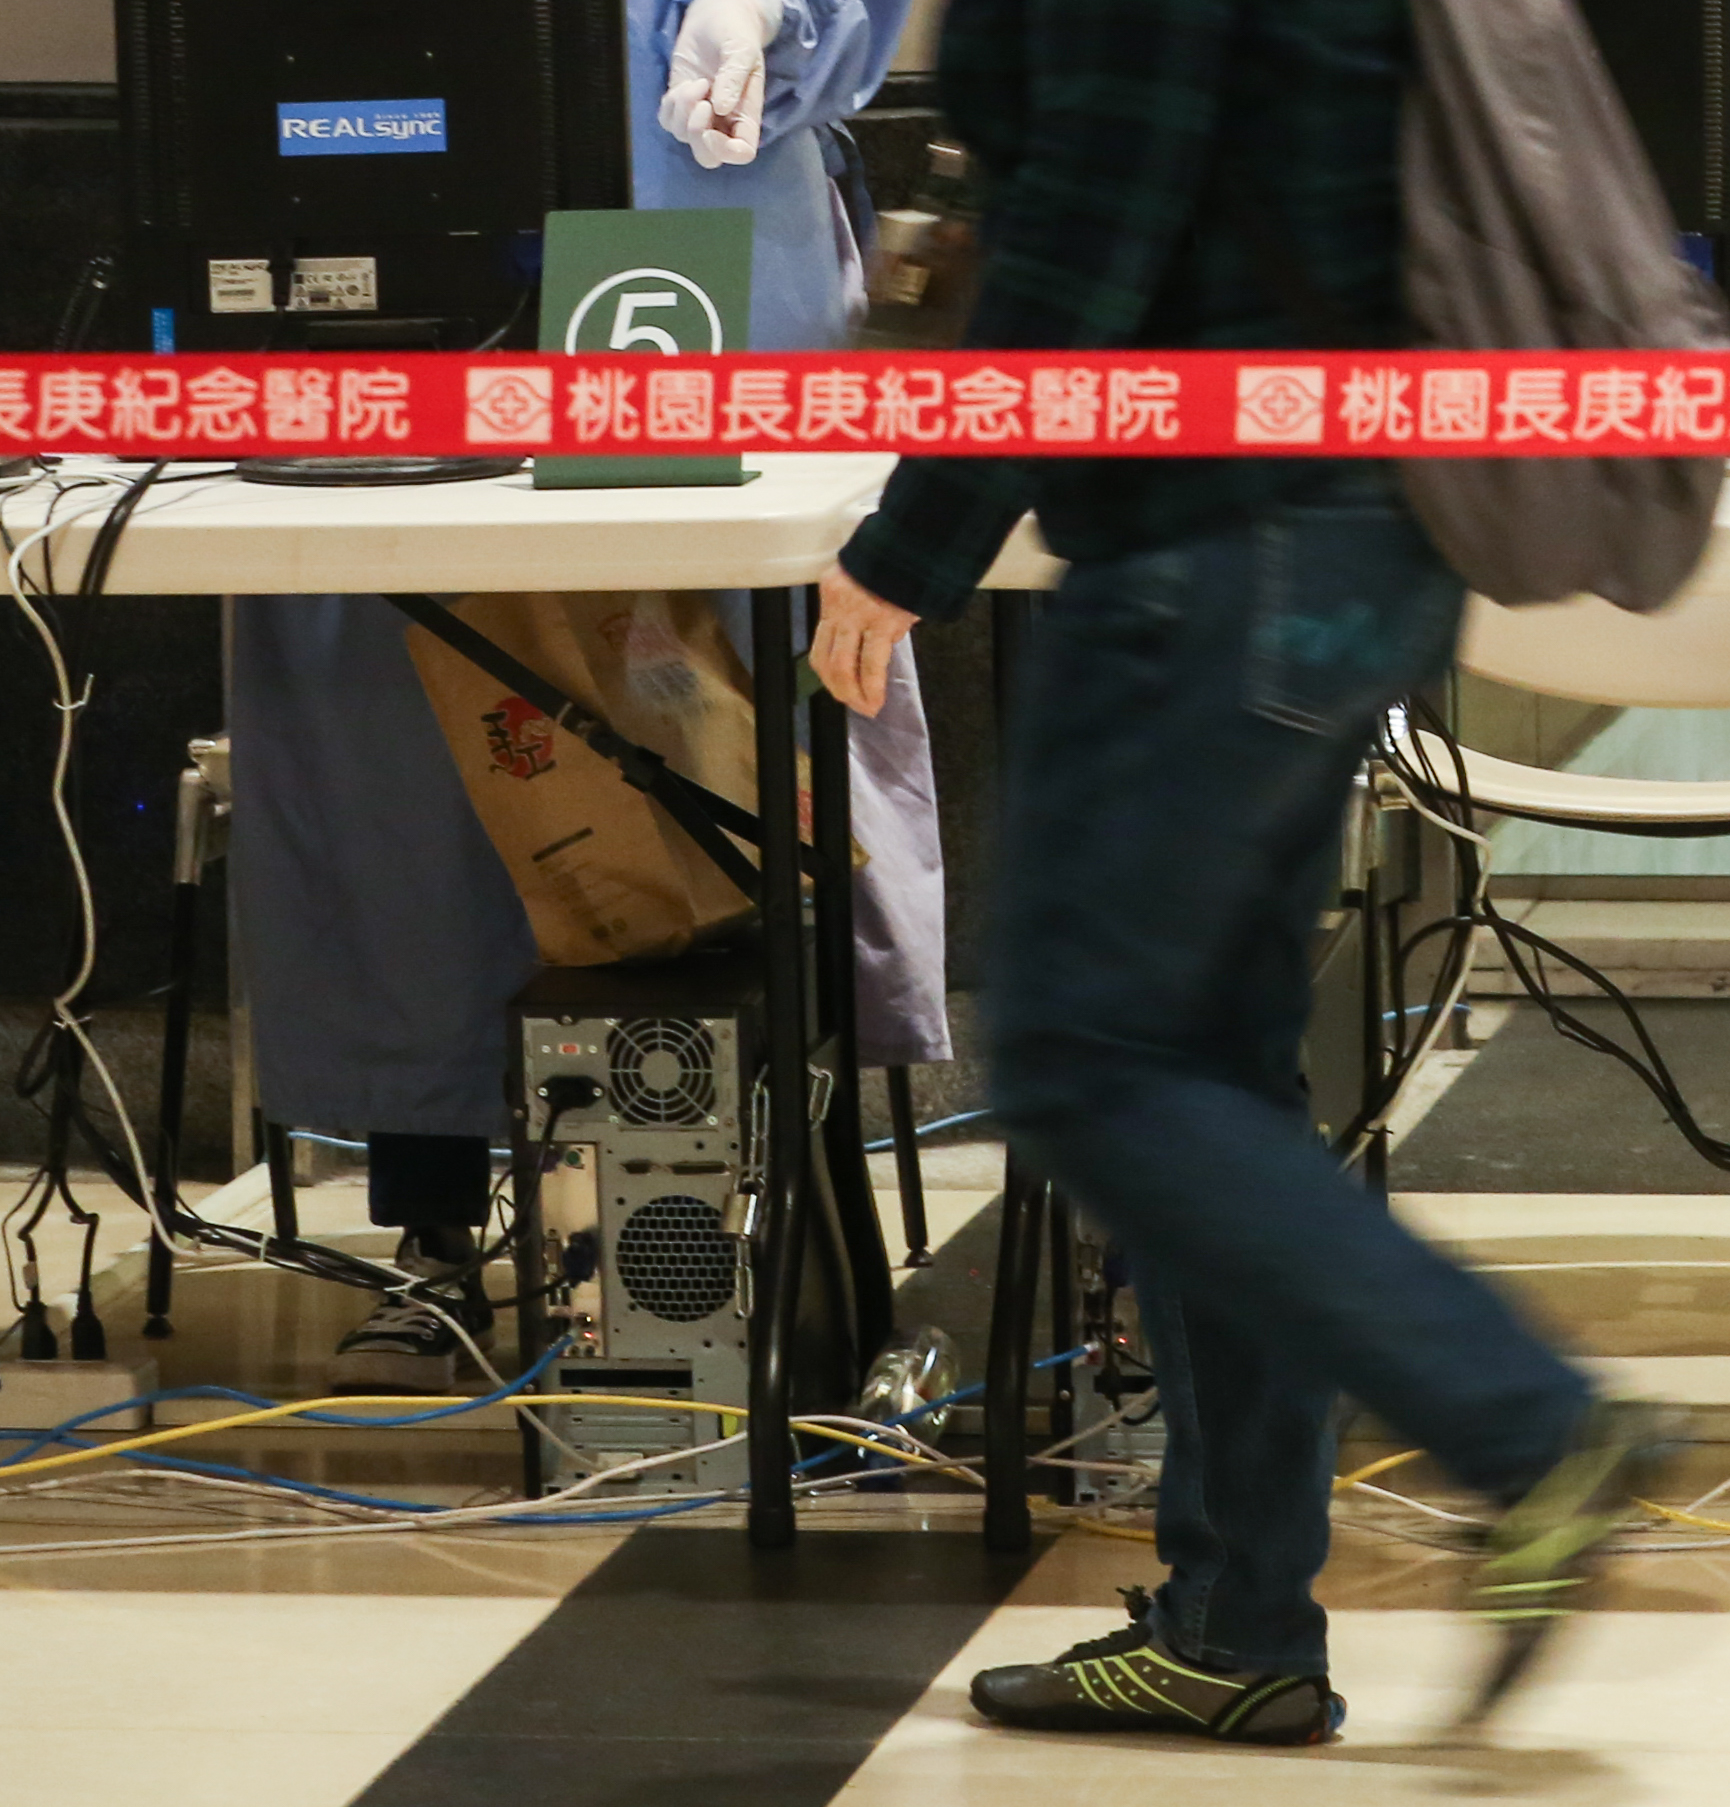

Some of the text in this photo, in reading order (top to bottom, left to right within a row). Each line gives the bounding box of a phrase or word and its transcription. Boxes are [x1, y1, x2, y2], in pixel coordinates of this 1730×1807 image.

[282, 117, 442, 140] REALsync
[567, 366, 1181, 442] 桃園長庚紀念醫院
